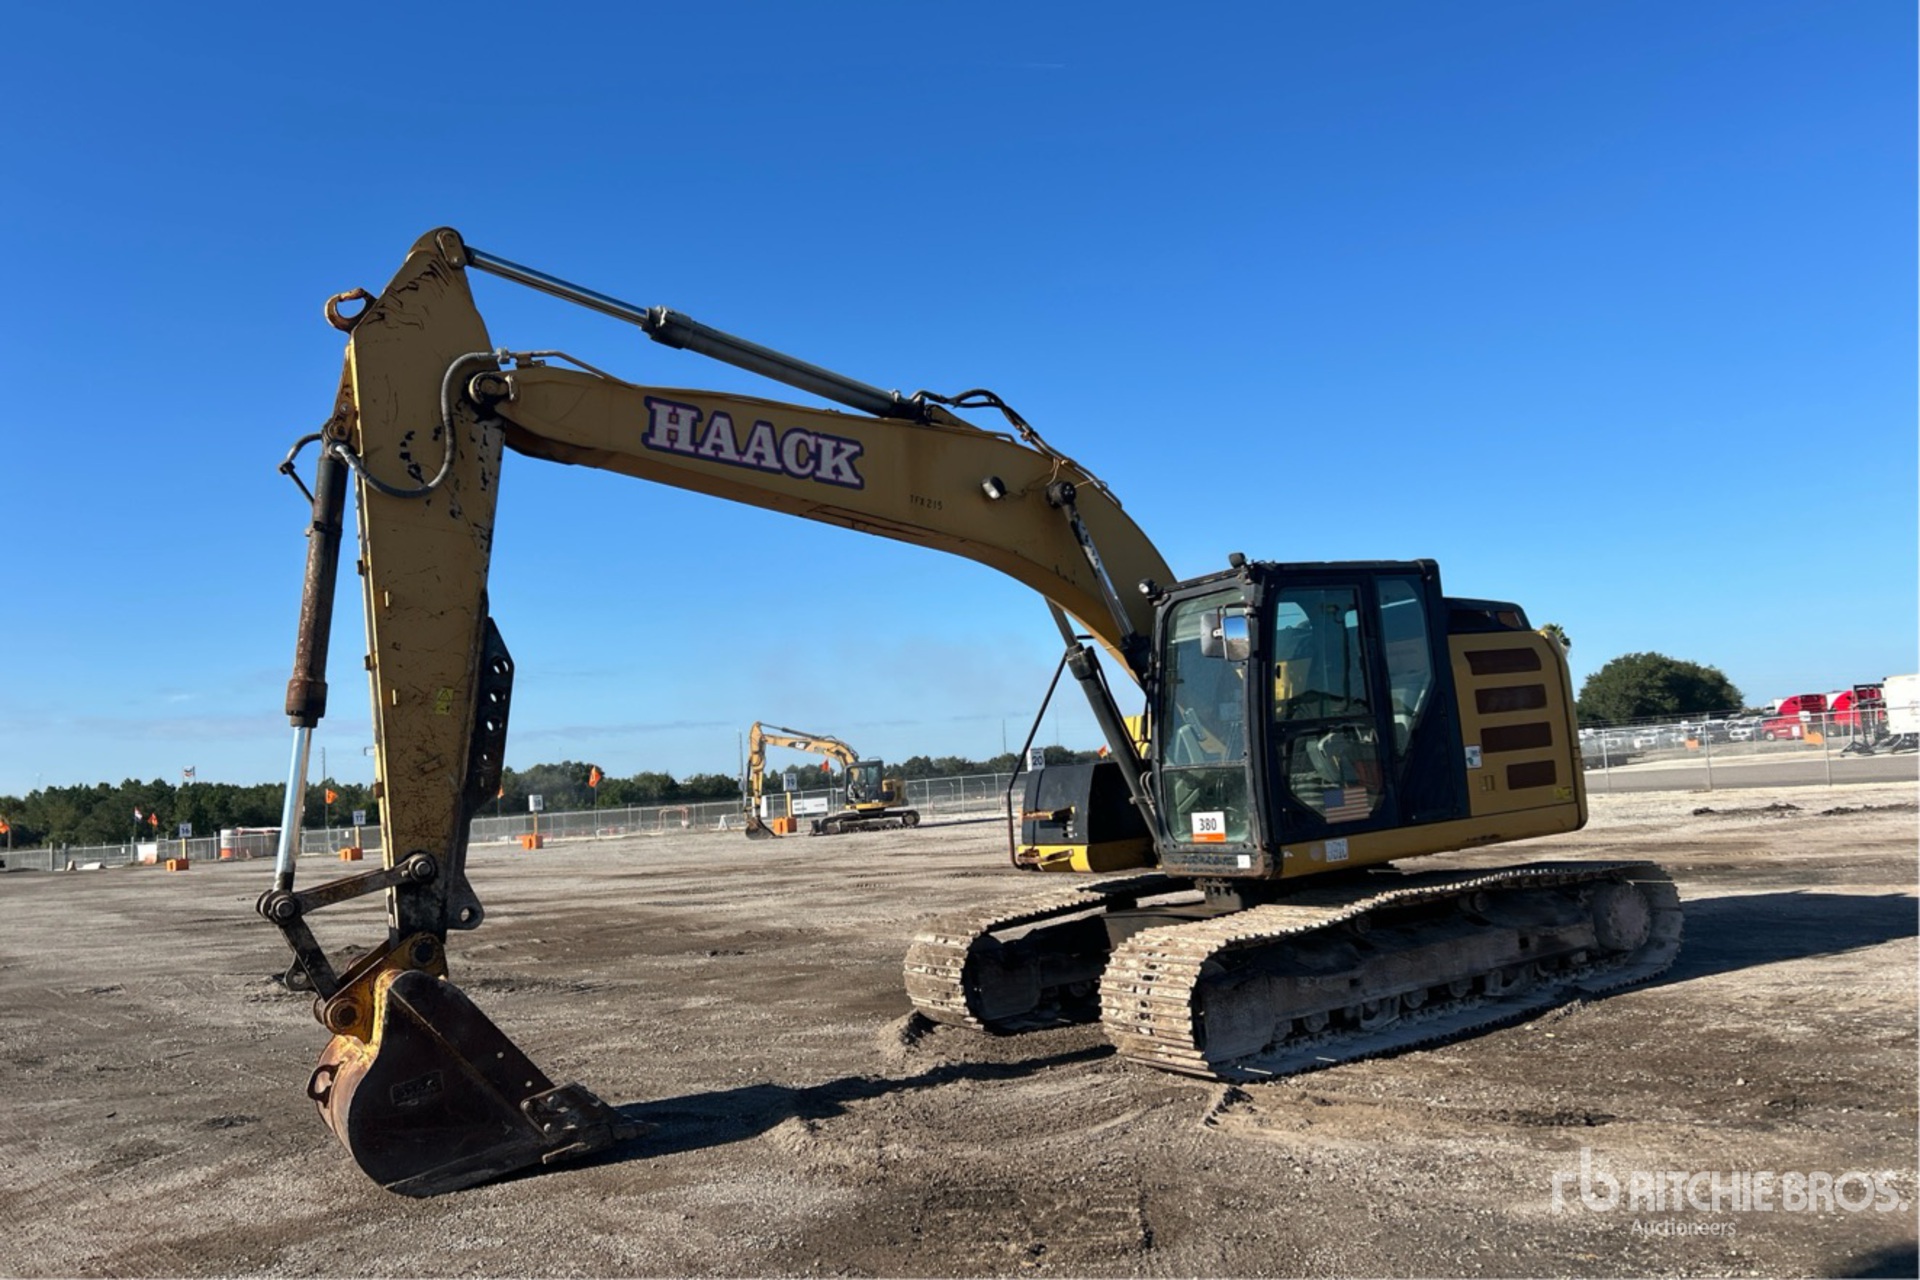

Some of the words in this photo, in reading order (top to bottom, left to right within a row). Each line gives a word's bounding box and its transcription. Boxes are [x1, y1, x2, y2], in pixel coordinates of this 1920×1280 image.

[646, 397, 864, 489] HAACK
[1032, 755, 1043, 766] 20
[1199, 817, 1217, 831] 380
